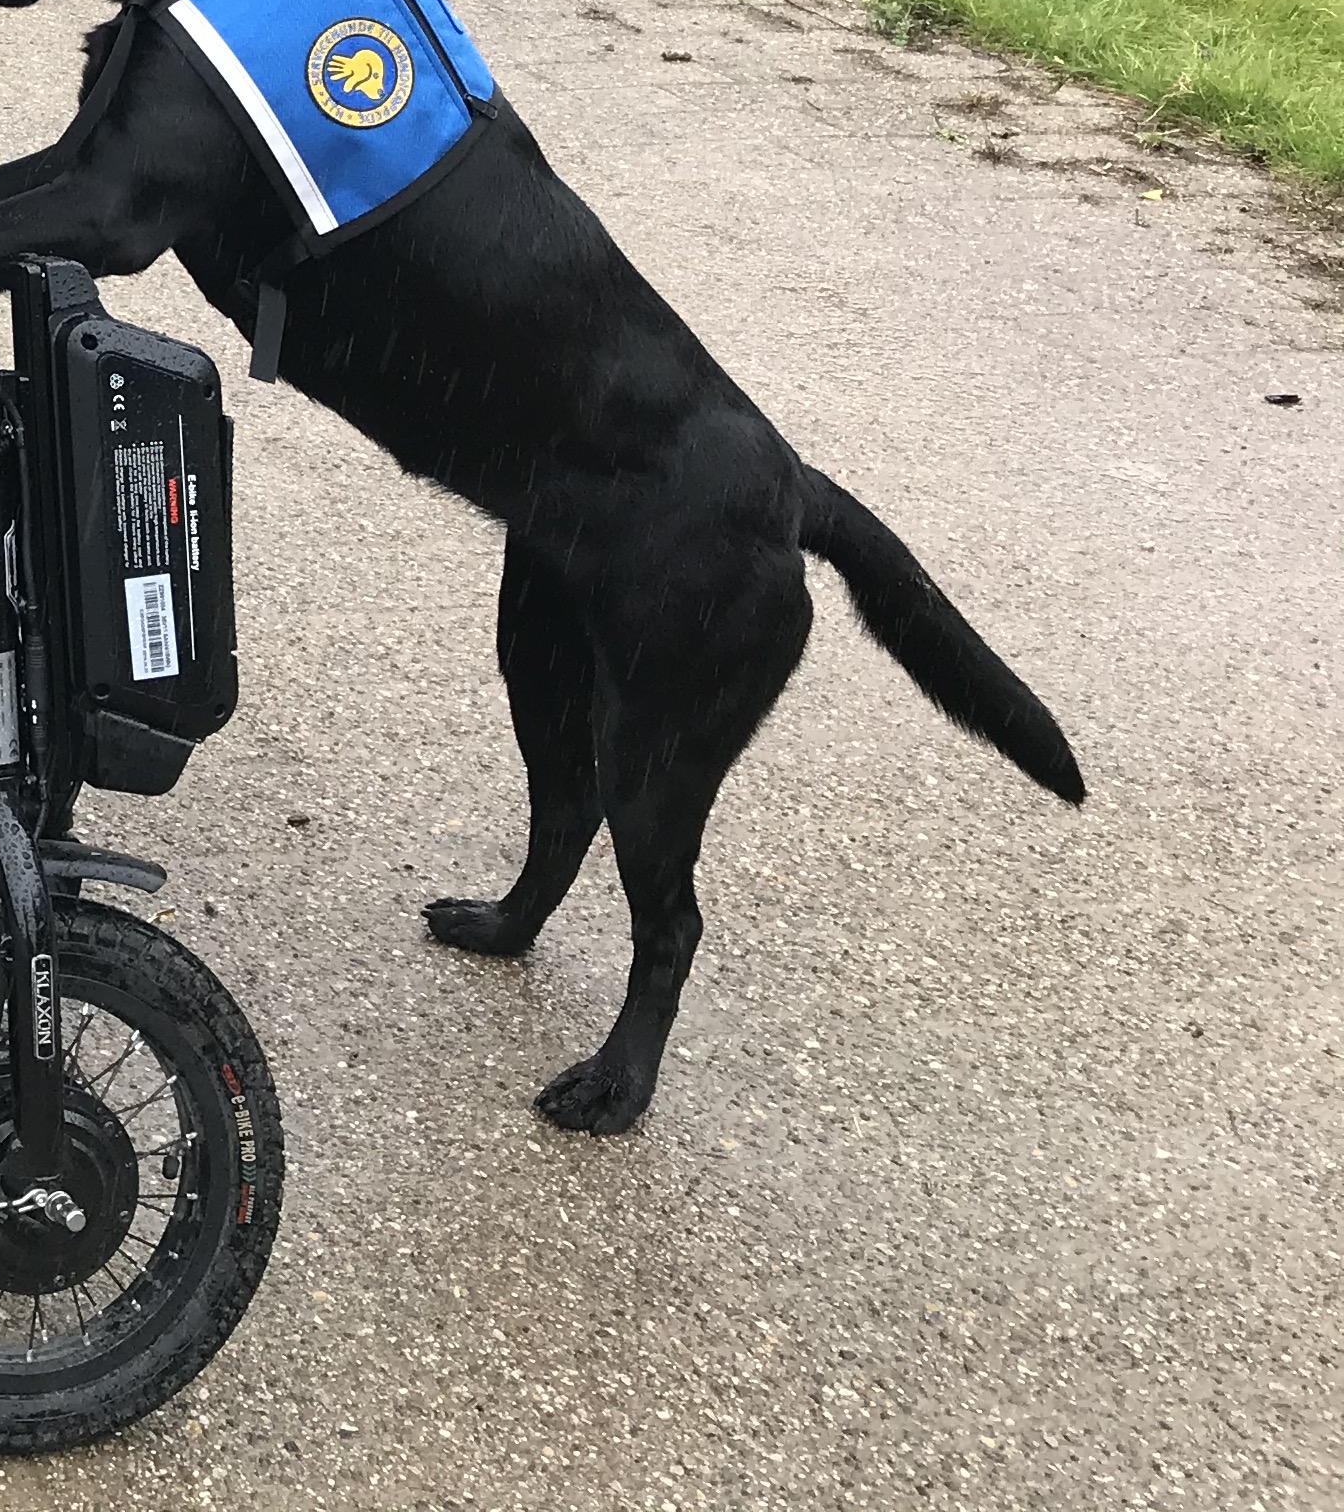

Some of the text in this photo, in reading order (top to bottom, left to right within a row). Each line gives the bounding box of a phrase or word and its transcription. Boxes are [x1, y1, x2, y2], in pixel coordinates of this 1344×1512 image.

[168, 477, 179, 525] WARNING
[187, 474, 197, 506] E-bike
[191, 536, 200, 572] battery
[36, 970, 53, 1045] KLAXON
[231, 1095, 254, 1138] e-BIKE
[240, 1140, 257, 1162] PRO
